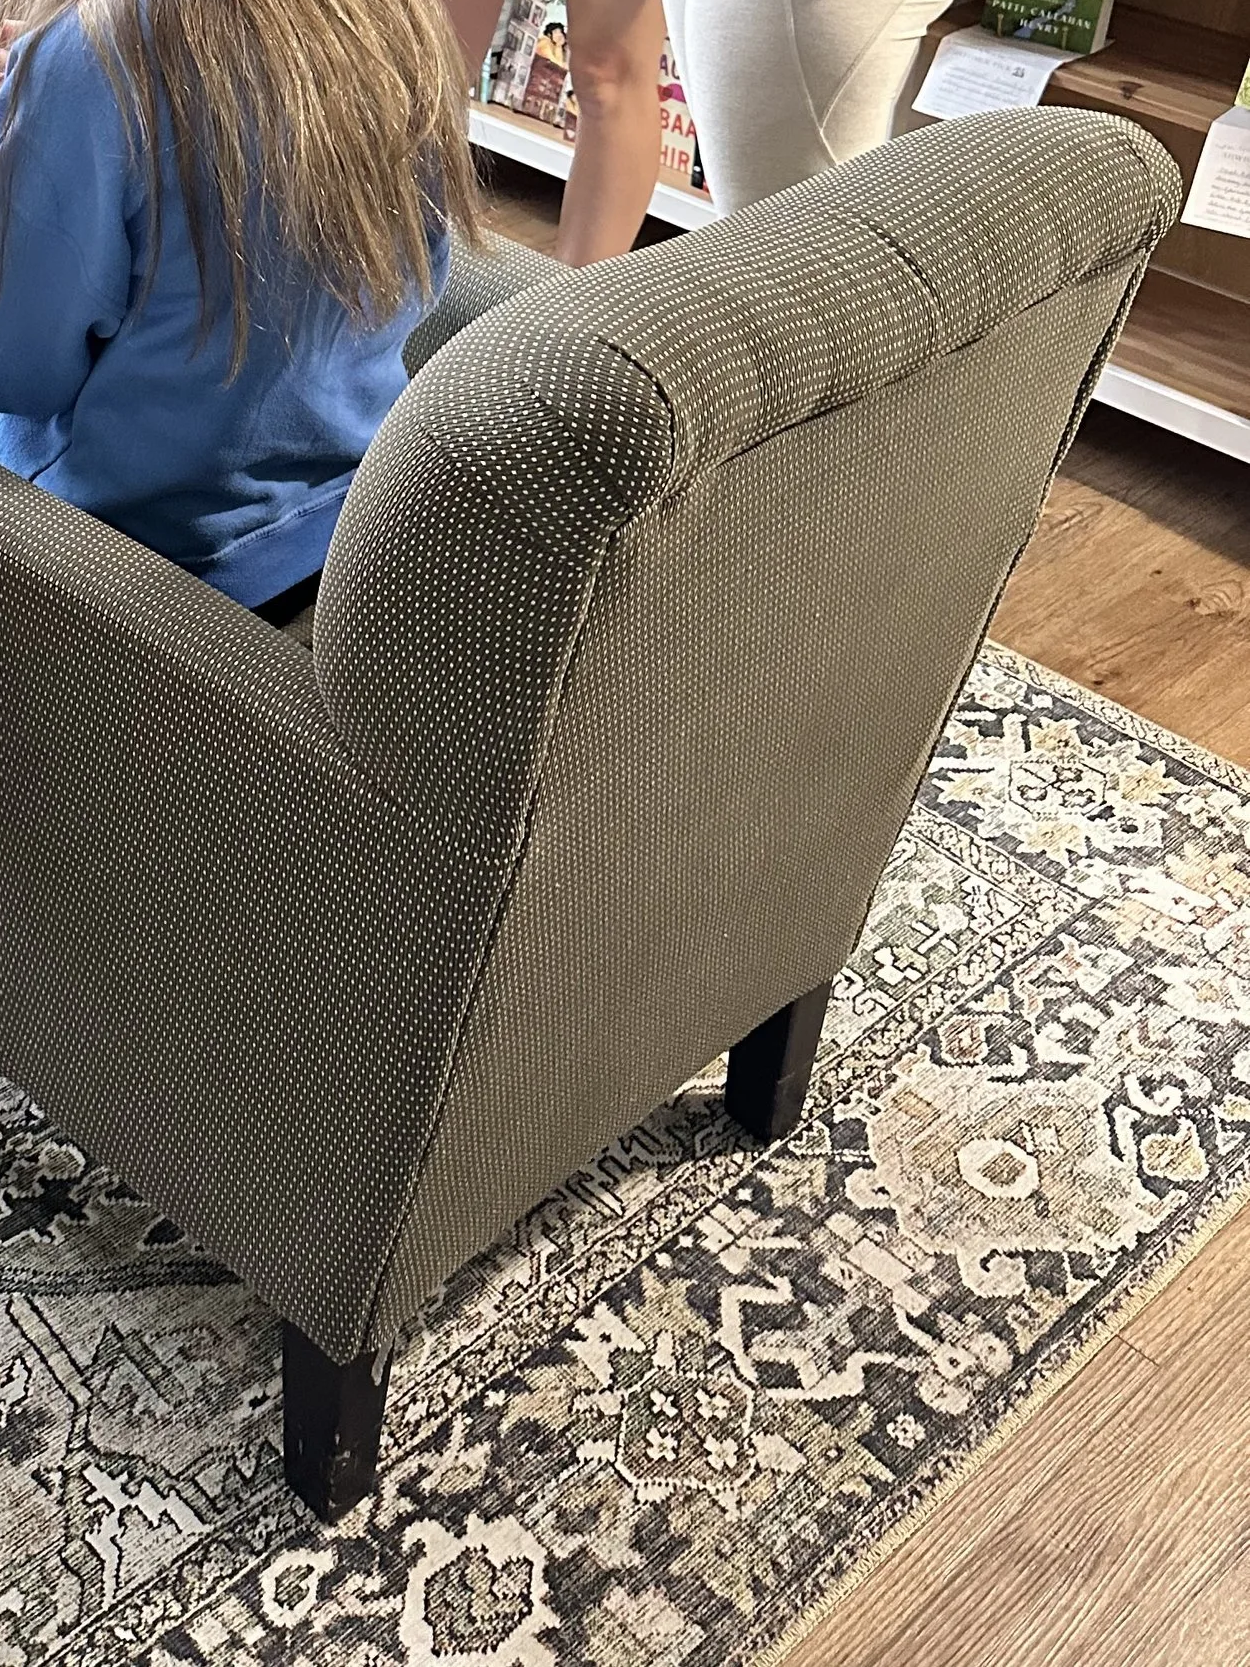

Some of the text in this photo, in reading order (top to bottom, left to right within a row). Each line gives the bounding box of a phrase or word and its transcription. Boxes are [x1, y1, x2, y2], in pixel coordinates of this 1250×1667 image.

[1019, 18, 1060, 35] HENRY
[1030, 6, 1092, 30] CALLAHAN
[661, 108, 697, 138] BAA
[659, 143, 691, 172] HIR
